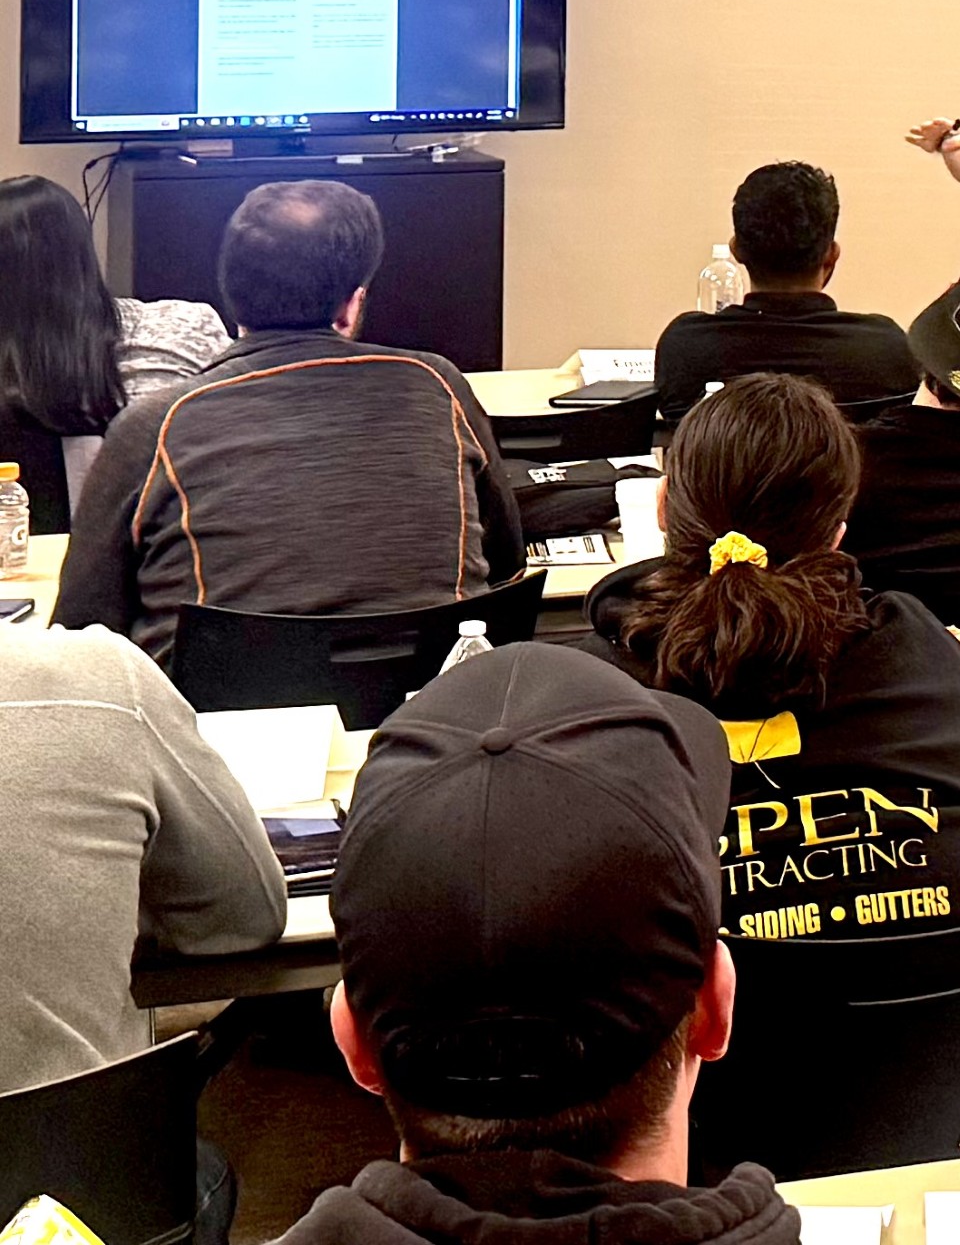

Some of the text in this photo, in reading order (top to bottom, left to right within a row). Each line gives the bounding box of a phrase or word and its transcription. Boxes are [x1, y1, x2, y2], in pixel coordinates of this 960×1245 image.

[718, 786, 940, 858] PEN
[739, 885, 951, 940] SIDING GUTTERS
